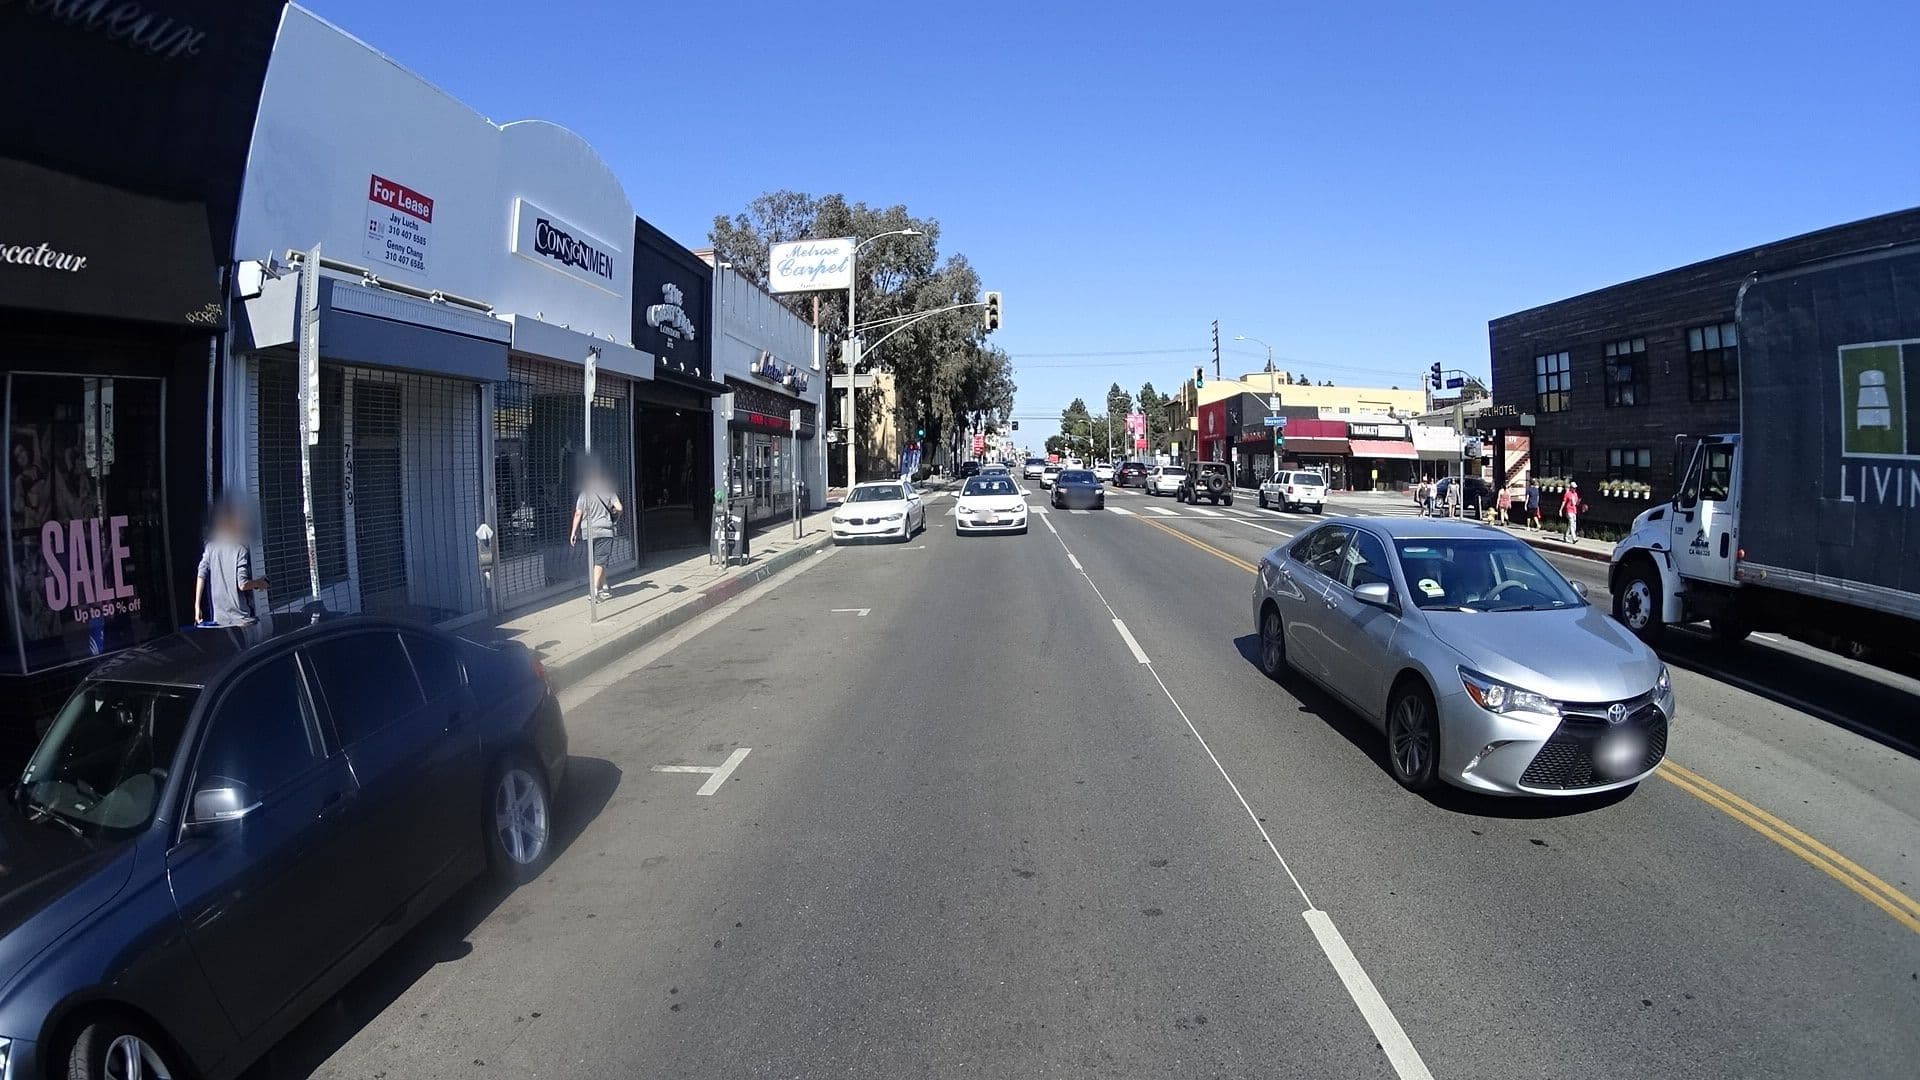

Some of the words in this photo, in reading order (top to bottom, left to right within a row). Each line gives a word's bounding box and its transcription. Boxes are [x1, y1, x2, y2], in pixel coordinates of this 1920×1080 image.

[373, 179, 396, 203] For
[398, 189, 430, 218] Lease
[389, 212, 402, 226] Jay
[388, 225, 400, 236] 310
[401, 229, 412, 241] 407
[385, 250, 398, 262] 310
[398, 254, 409, 266] 407
[386, 239, 405, 255] Genny
[406, 245, 424, 261] Chang
[785, 243, 840, 258] Melrose
[777, 256, 849, 282] Carpet
[344, 443, 354, 506] 7959
[41, 515, 134, 611] SALE
[74, 608, 89, 623] Up
[90, 606, 101, 618] to
[102, 603, 115, 616] 50
[116, 601, 127, 613] %
[128, 598, 141, 611] off
